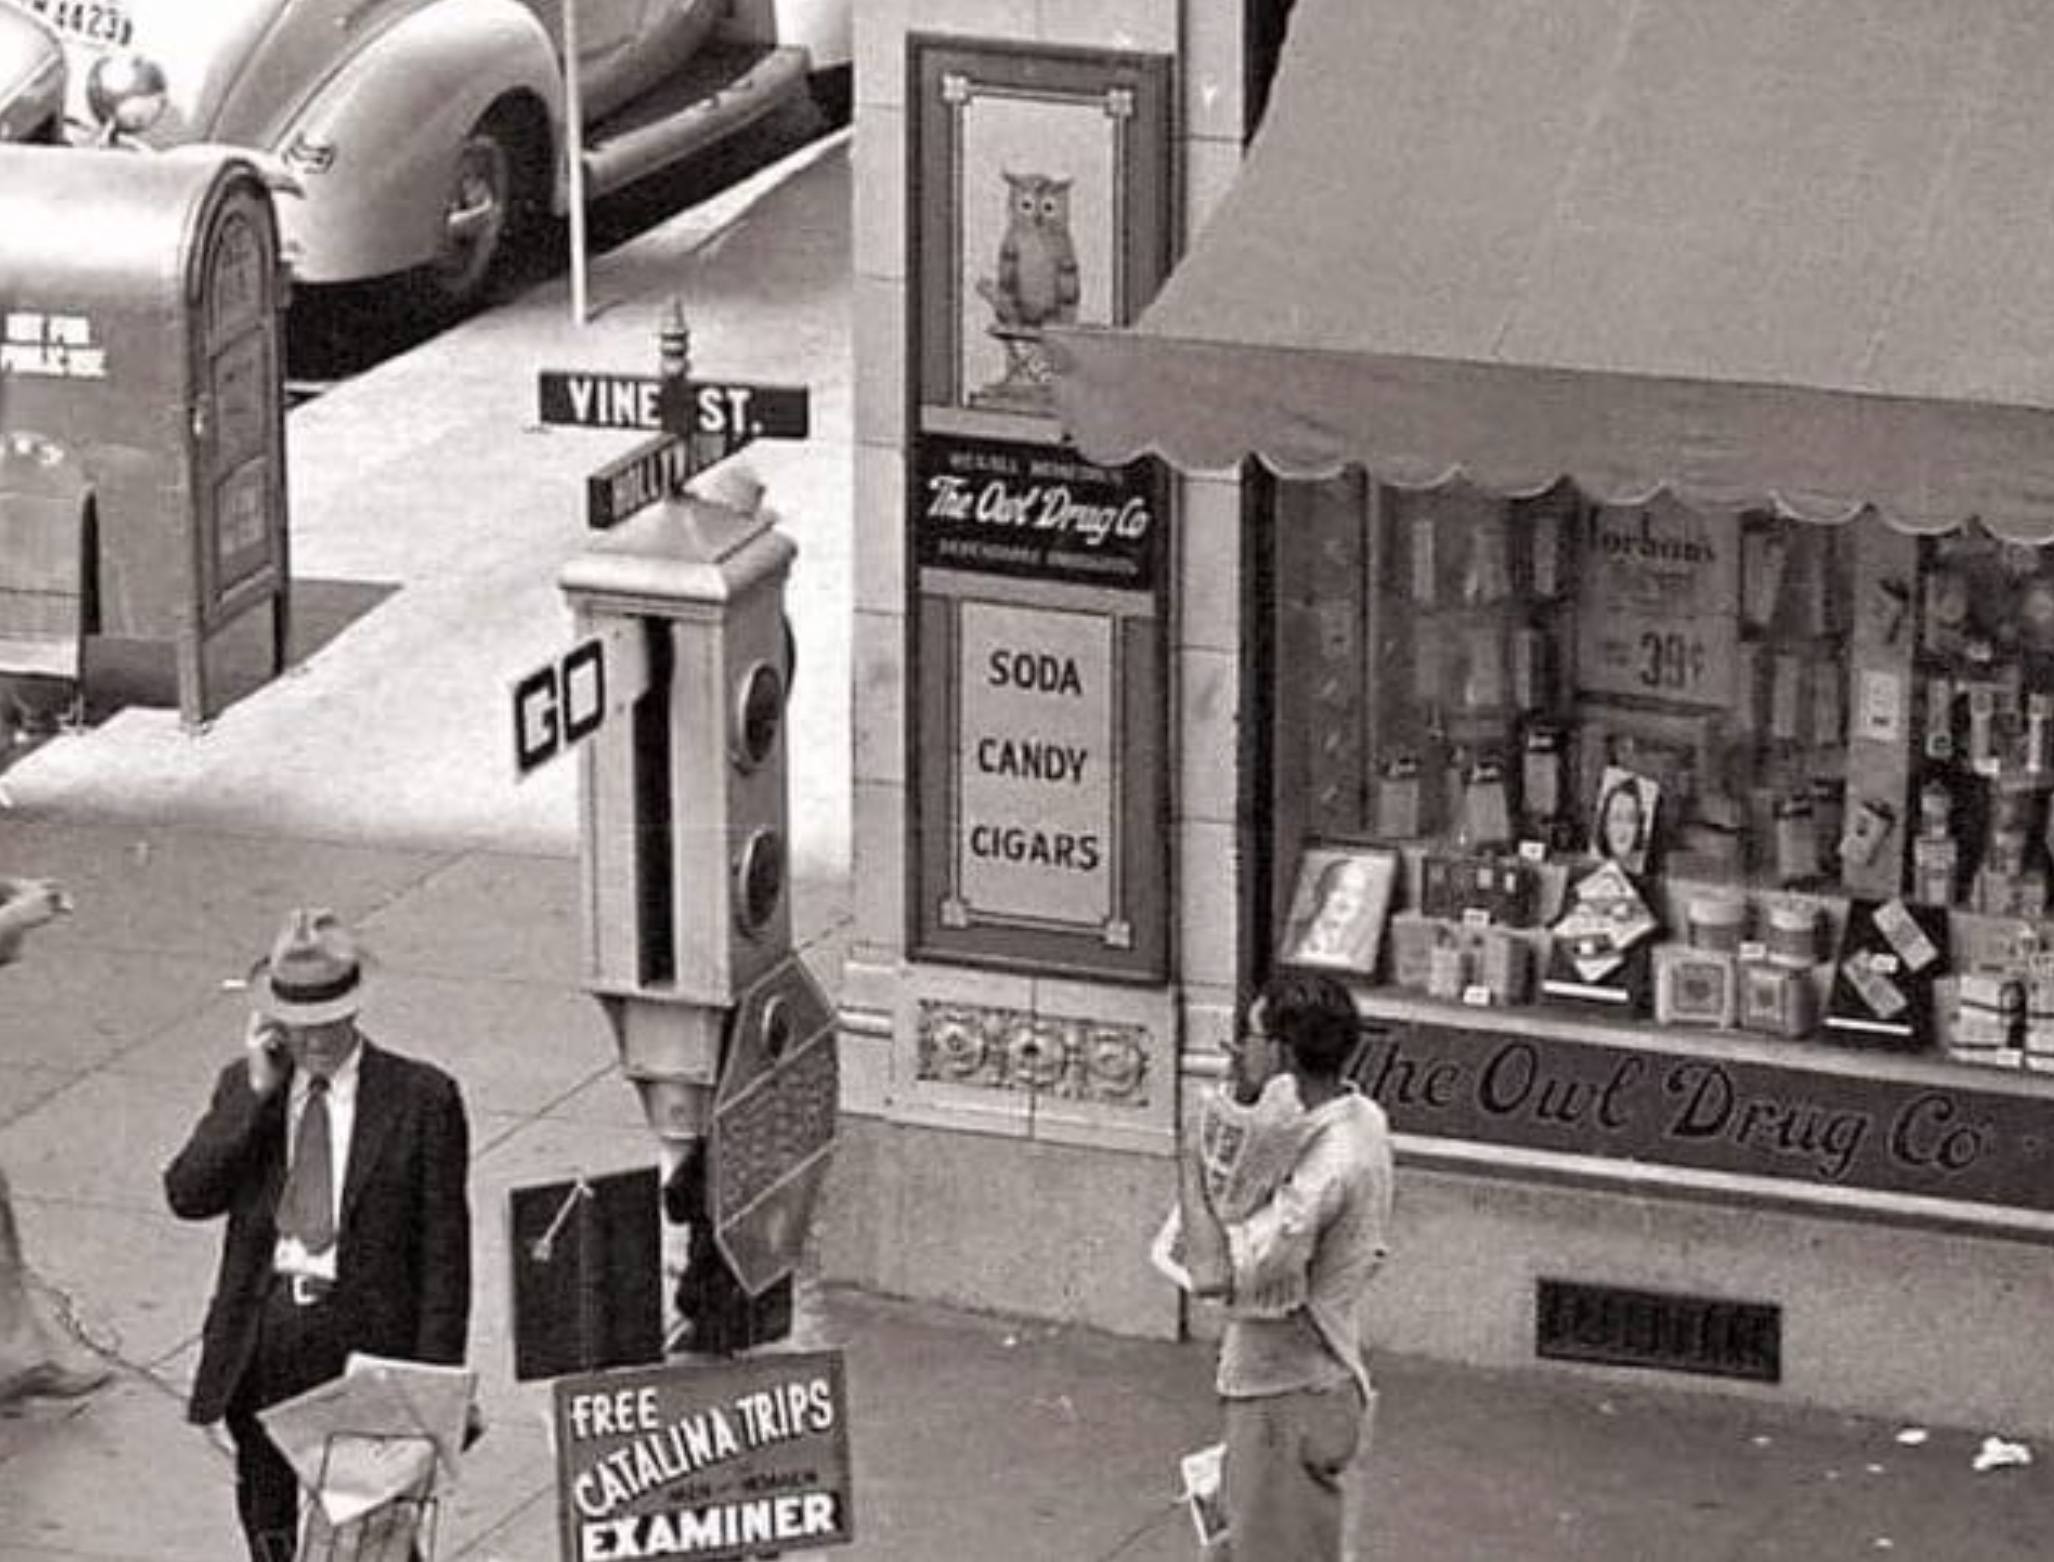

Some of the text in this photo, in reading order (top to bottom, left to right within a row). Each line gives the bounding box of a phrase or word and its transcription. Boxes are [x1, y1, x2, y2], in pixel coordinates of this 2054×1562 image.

[568, 377, 765, 436] VINE ST.
[929, 474, 1150, 546] The Owl Drug Co
[514, 637, 606, 775] GO
[988, 650, 1083, 698] SODA
[977, 737, 1088, 785] CANDY
[969, 825, 1100, 872] CIGARS
[1346, 1025, 1983, 1178] The Owl Drug Co
[570, 1385, 661, 1439] FREE
[575, 1377, 835, 1517] CATALINA TRIPS
[581, 1493, 834, 1562] EXAMINER
